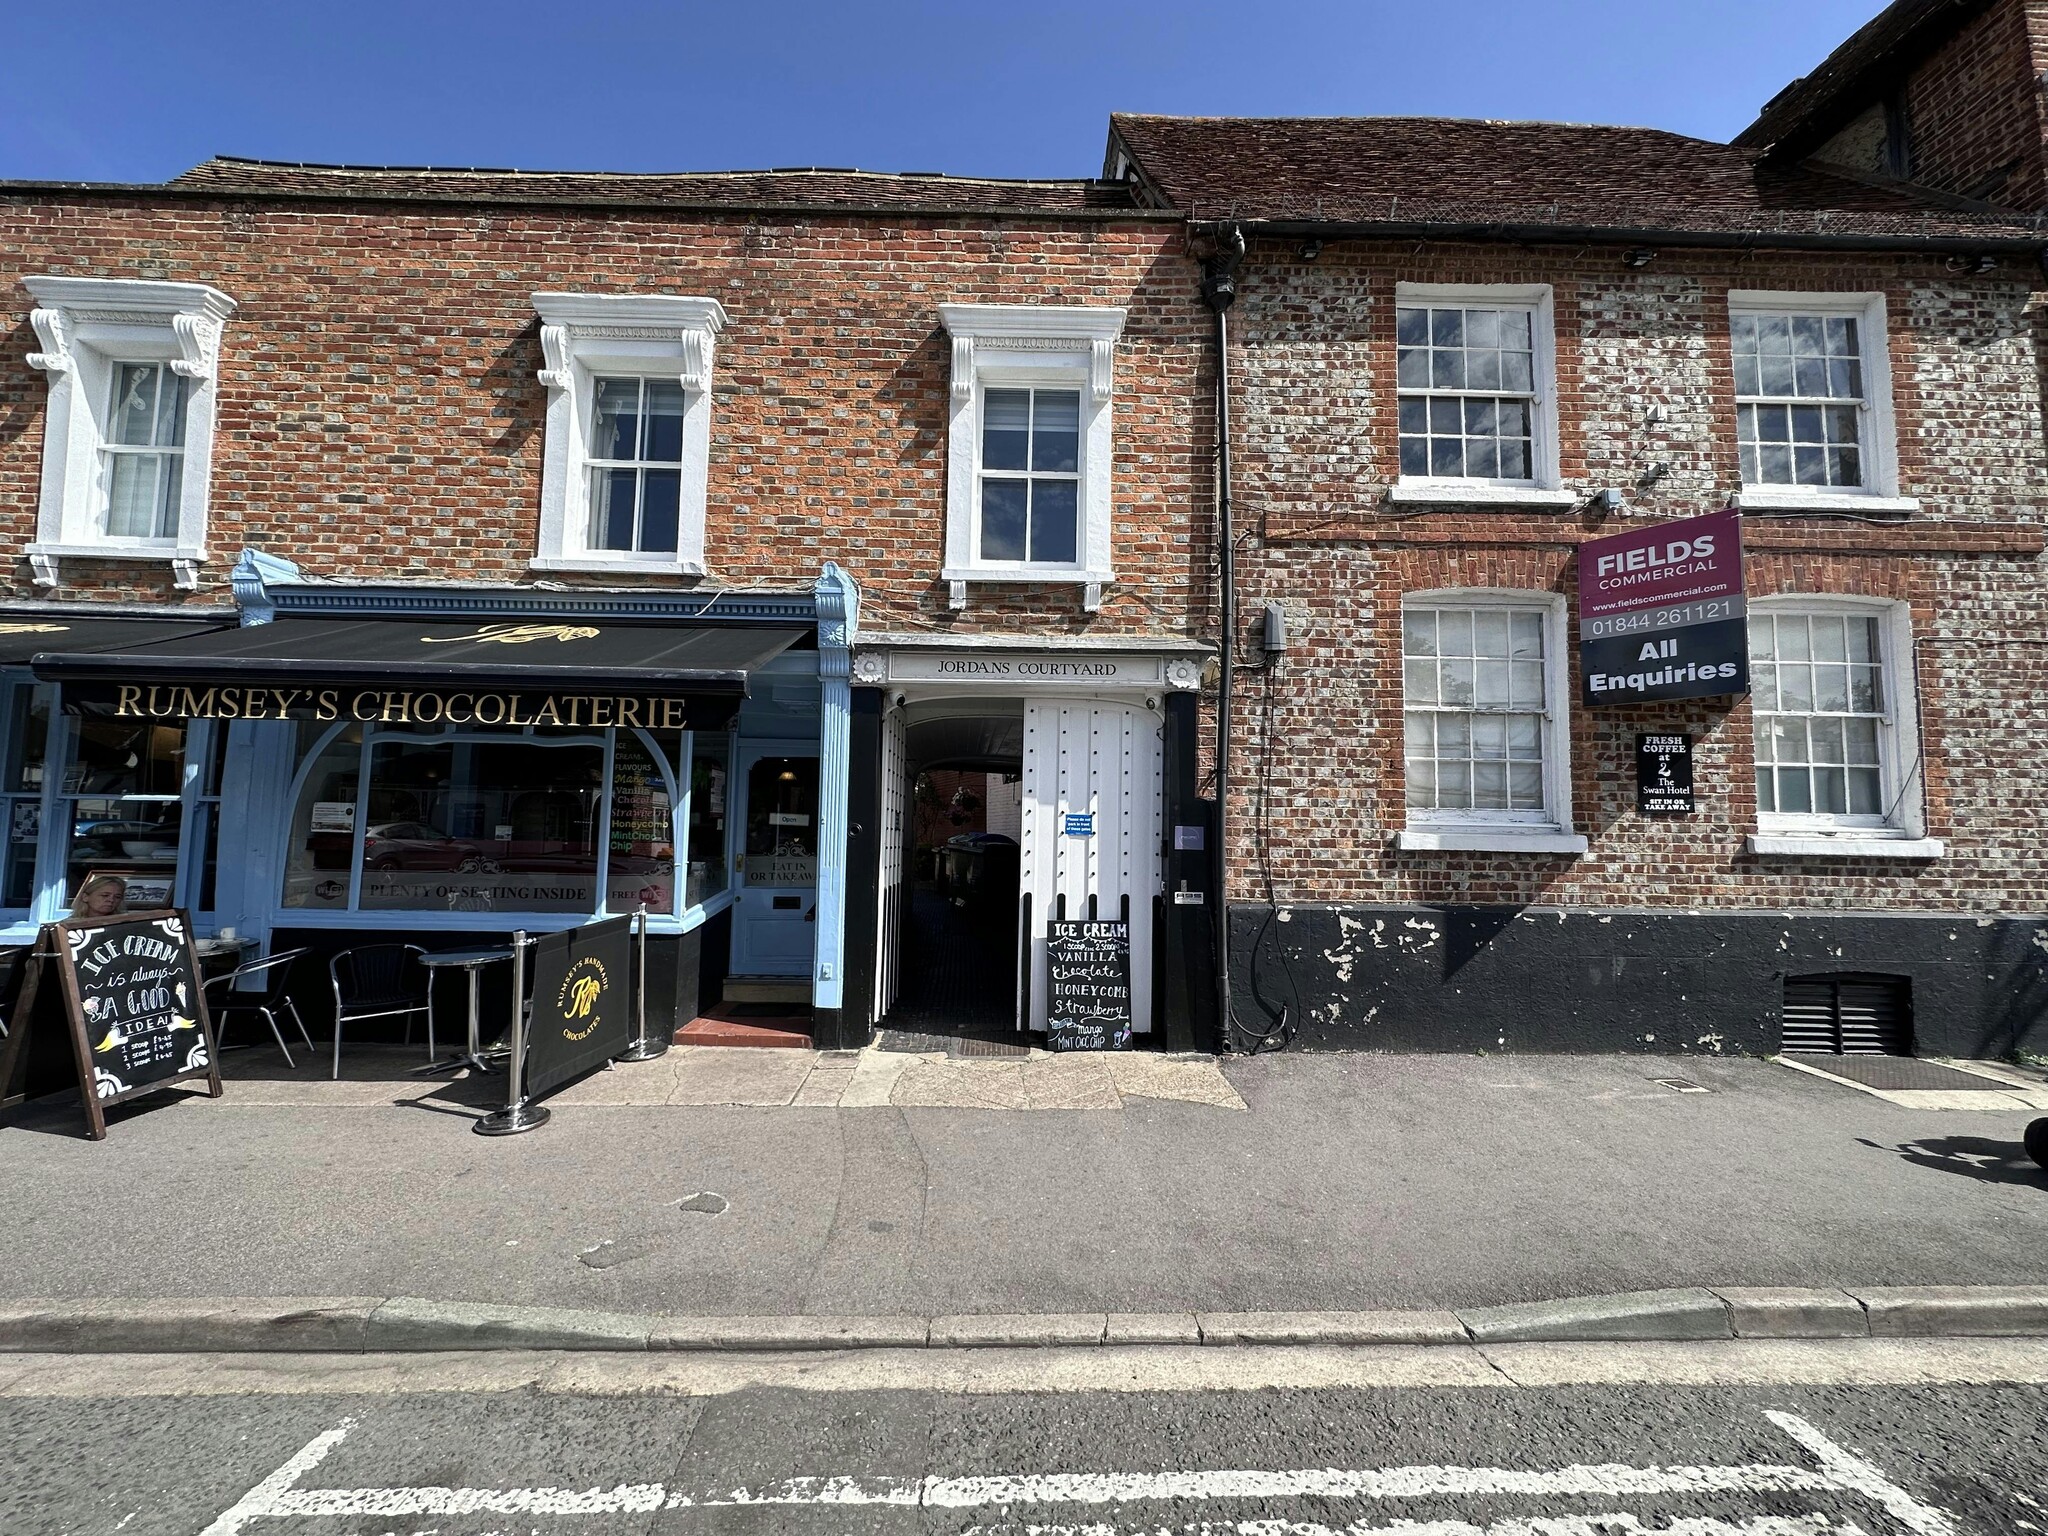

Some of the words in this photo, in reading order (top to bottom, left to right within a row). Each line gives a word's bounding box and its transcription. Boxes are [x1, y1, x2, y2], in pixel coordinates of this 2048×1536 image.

[1597, 535, 1716, 577] FIELDS
[1599, 559, 1718, 590] COMMERCIAL
[1592, 583, 1728, 611] www.fieldscommercial.com
[1592, 614, 1650, 636] 01844
[1656, 600, 1730, 626] 261121
[1638, 638, 1678, 661] All
[938, 660, 1011, 675] JORDANS
[1018, 662, 1117, 676] COURTYARD
[1589, 662, 1737, 692] Enquiries
[114, 685, 338, 721] RUMSEY'S
[352, 690, 688, 730] CHOCOLATERIE
[615, 742, 627, 750] ICE
[1645, 736, 1683, 745] FRESH
[1642, 745, 1686, 753] COFFEE
[614, 764, 652, 772] FLAVOURS
[1657, 762, 1671, 777] 2
[1657, 778, 1675, 786] The
[1643, 785, 1665, 794] Swan
[1667, 785, 1690, 795] Hotel
[612, 819, 669, 831] Honeycomb
[610, 841, 633, 853] Chip
[772, 862, 793, 871] EAT
[796, 862, 806, 871] IN
[751, 872, 766, 881] OR
[370, 884, 432, 898] PLENTY
[533, 886, 587, 900] INSIDE
[612, 890, 638, 900] FREE
[1054, 923, 1077, 937] ICE
[1083, 923, 1127, 938] CREAM
[81, 939, 121, 977] ICE
[123, 935, 179, 965] CREAM
[1057, 951, 1117, 962] VANILLA
[106, 972, 126, 988] is
[129, 966, 169, 989] always
[584, 956, 609, 990] HANDMADE
[1055, 983, 1128, 998] HONEYCOMB
[127, 987, 170, 1015] GOOD
[1054, 999, 1123, 1017] Strawberry
[562, 1015, 601, 1041] CHOCOLATES
